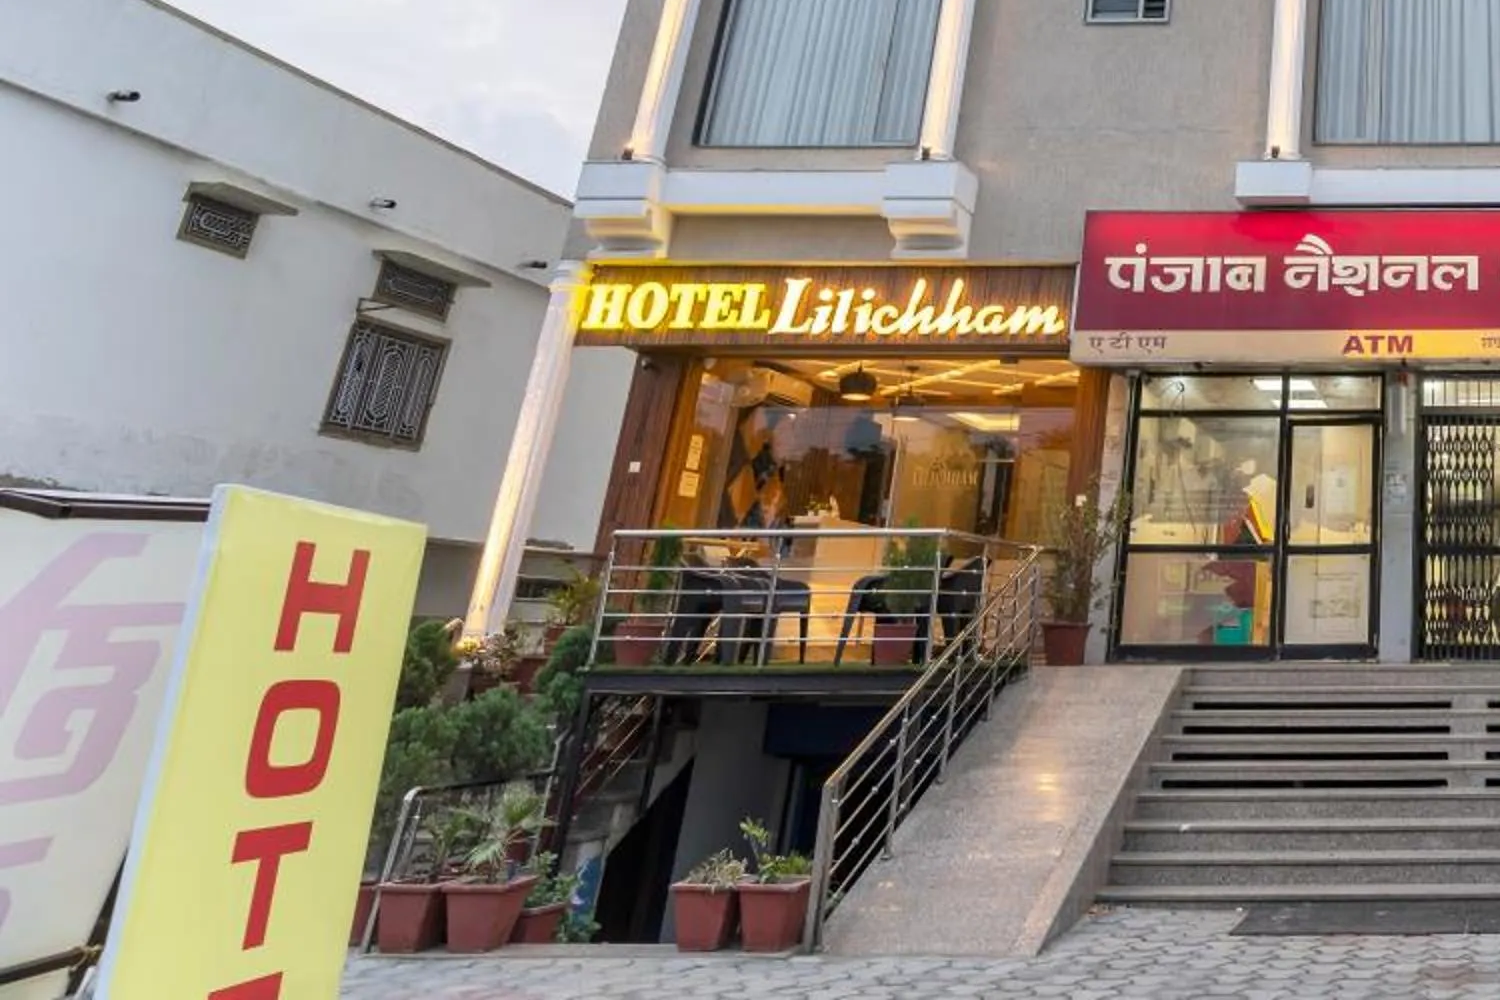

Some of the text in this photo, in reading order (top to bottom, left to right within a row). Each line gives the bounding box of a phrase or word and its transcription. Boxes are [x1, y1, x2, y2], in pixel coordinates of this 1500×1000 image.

[580, 278, 1065, 335] HOTEL Lilichham
[1343, 335, 1413, 354] ATM
[206, 540, 371, 1000] HOT
